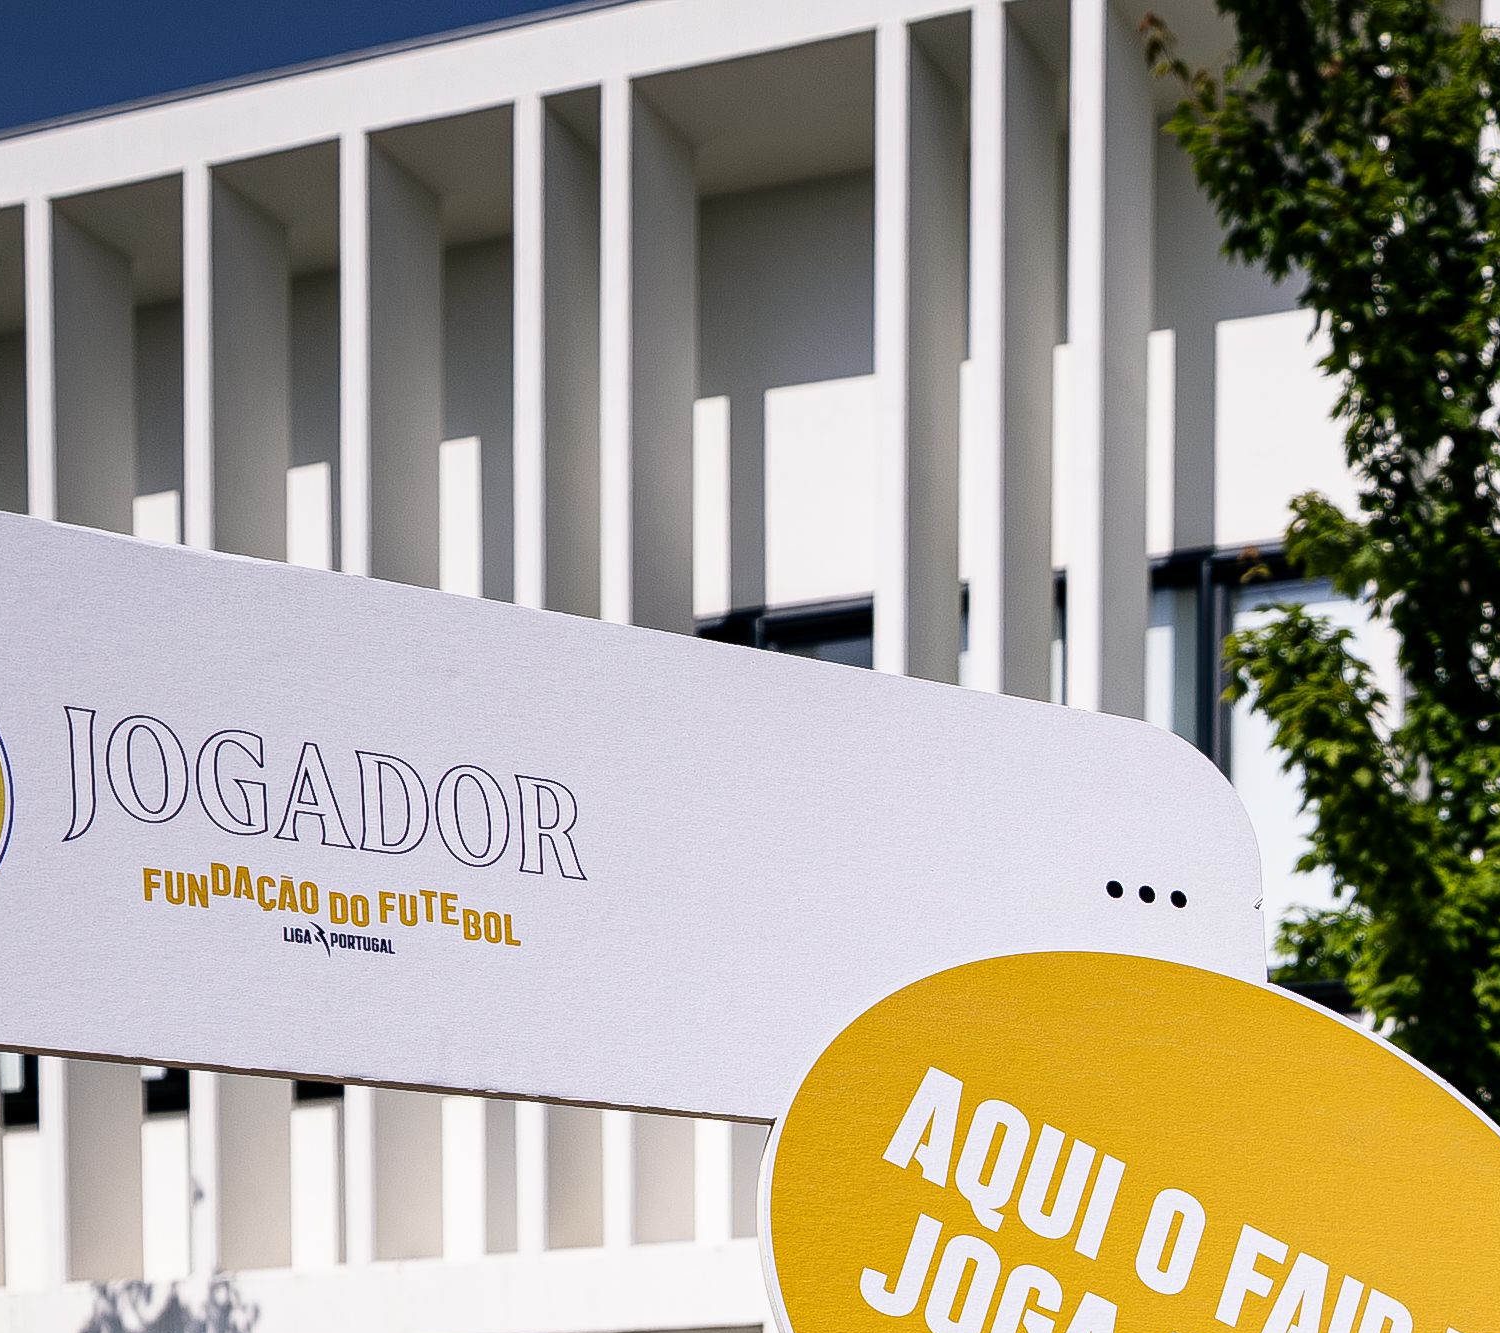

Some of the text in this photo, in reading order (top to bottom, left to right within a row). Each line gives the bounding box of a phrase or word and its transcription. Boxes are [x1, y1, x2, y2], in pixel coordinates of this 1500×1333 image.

[62, 705, 588, 881] JOGADOR
[142, 862, 523, 948] FUNDAÇÃO DO FUTEBOL
[282, 926, 396, 956] LIGA PORTUGAL
[881, 1065, 1126, 1262] AQUI
[1133, 1187, 1208, 1296] O
